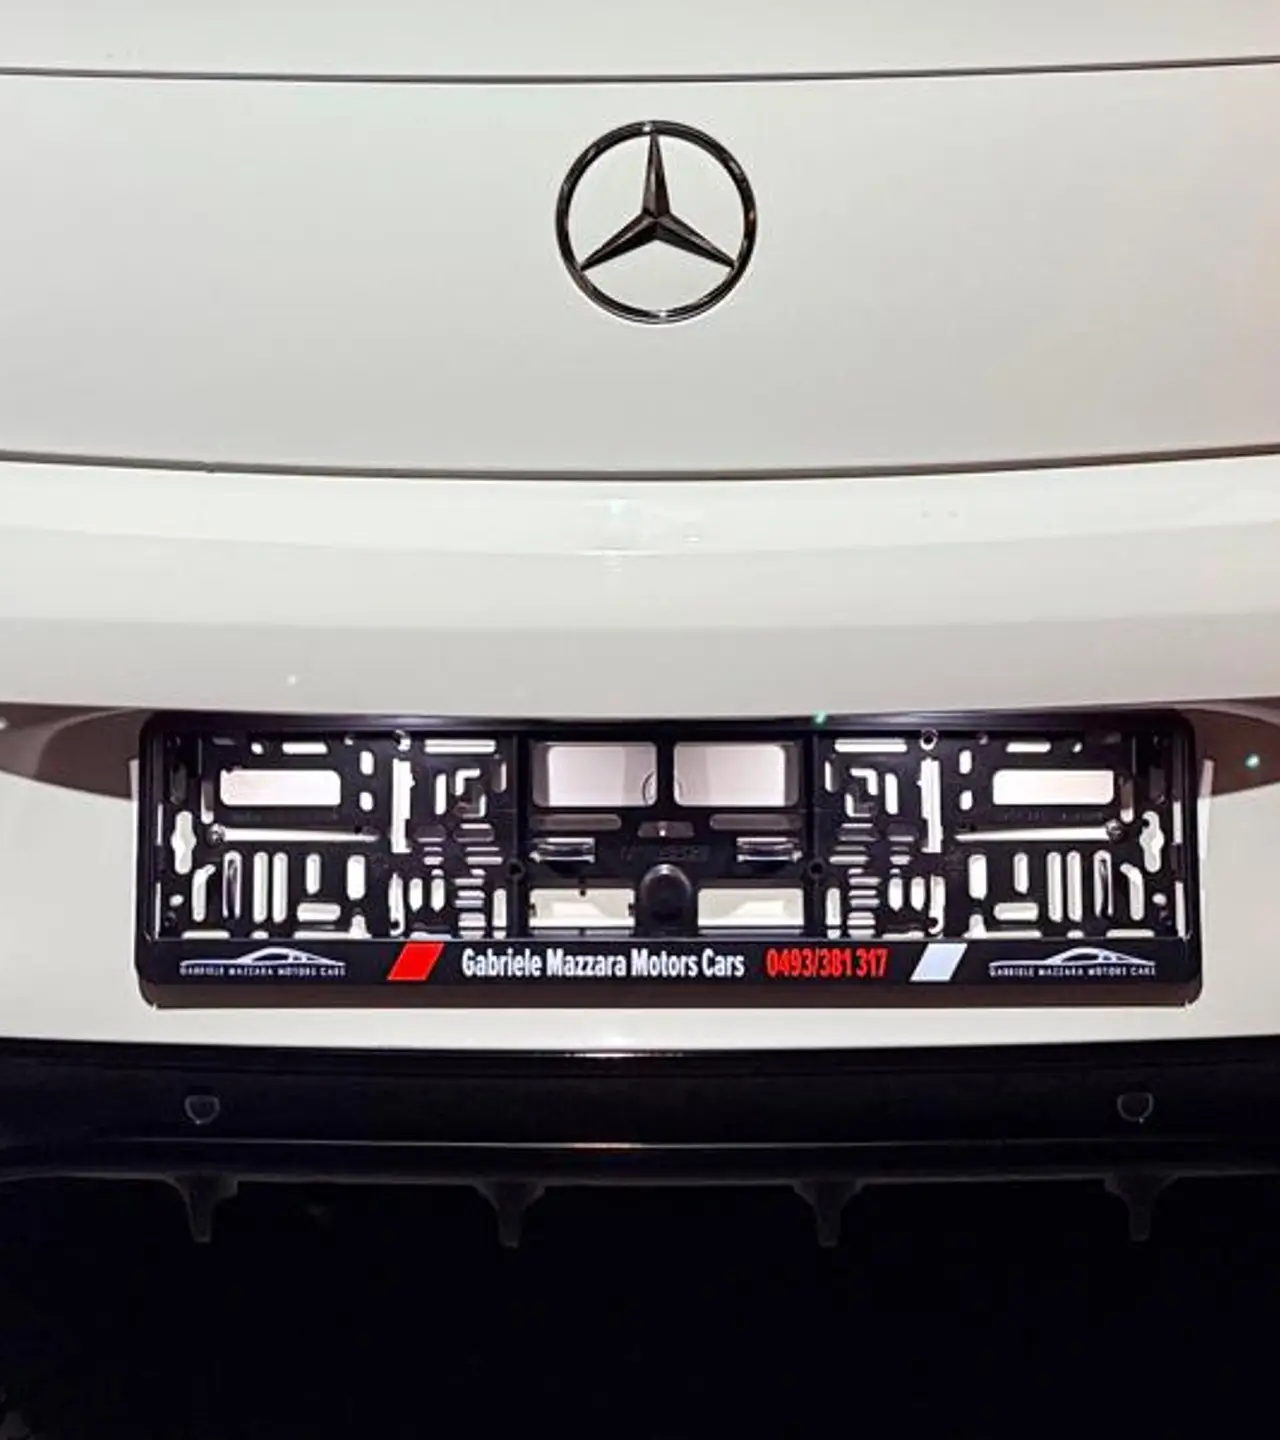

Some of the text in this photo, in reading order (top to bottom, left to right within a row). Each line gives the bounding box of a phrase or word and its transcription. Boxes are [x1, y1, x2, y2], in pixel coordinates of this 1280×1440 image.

[462, 947, 888, 978] Gabriele Mazzara Motors Cars 0493/381 317
